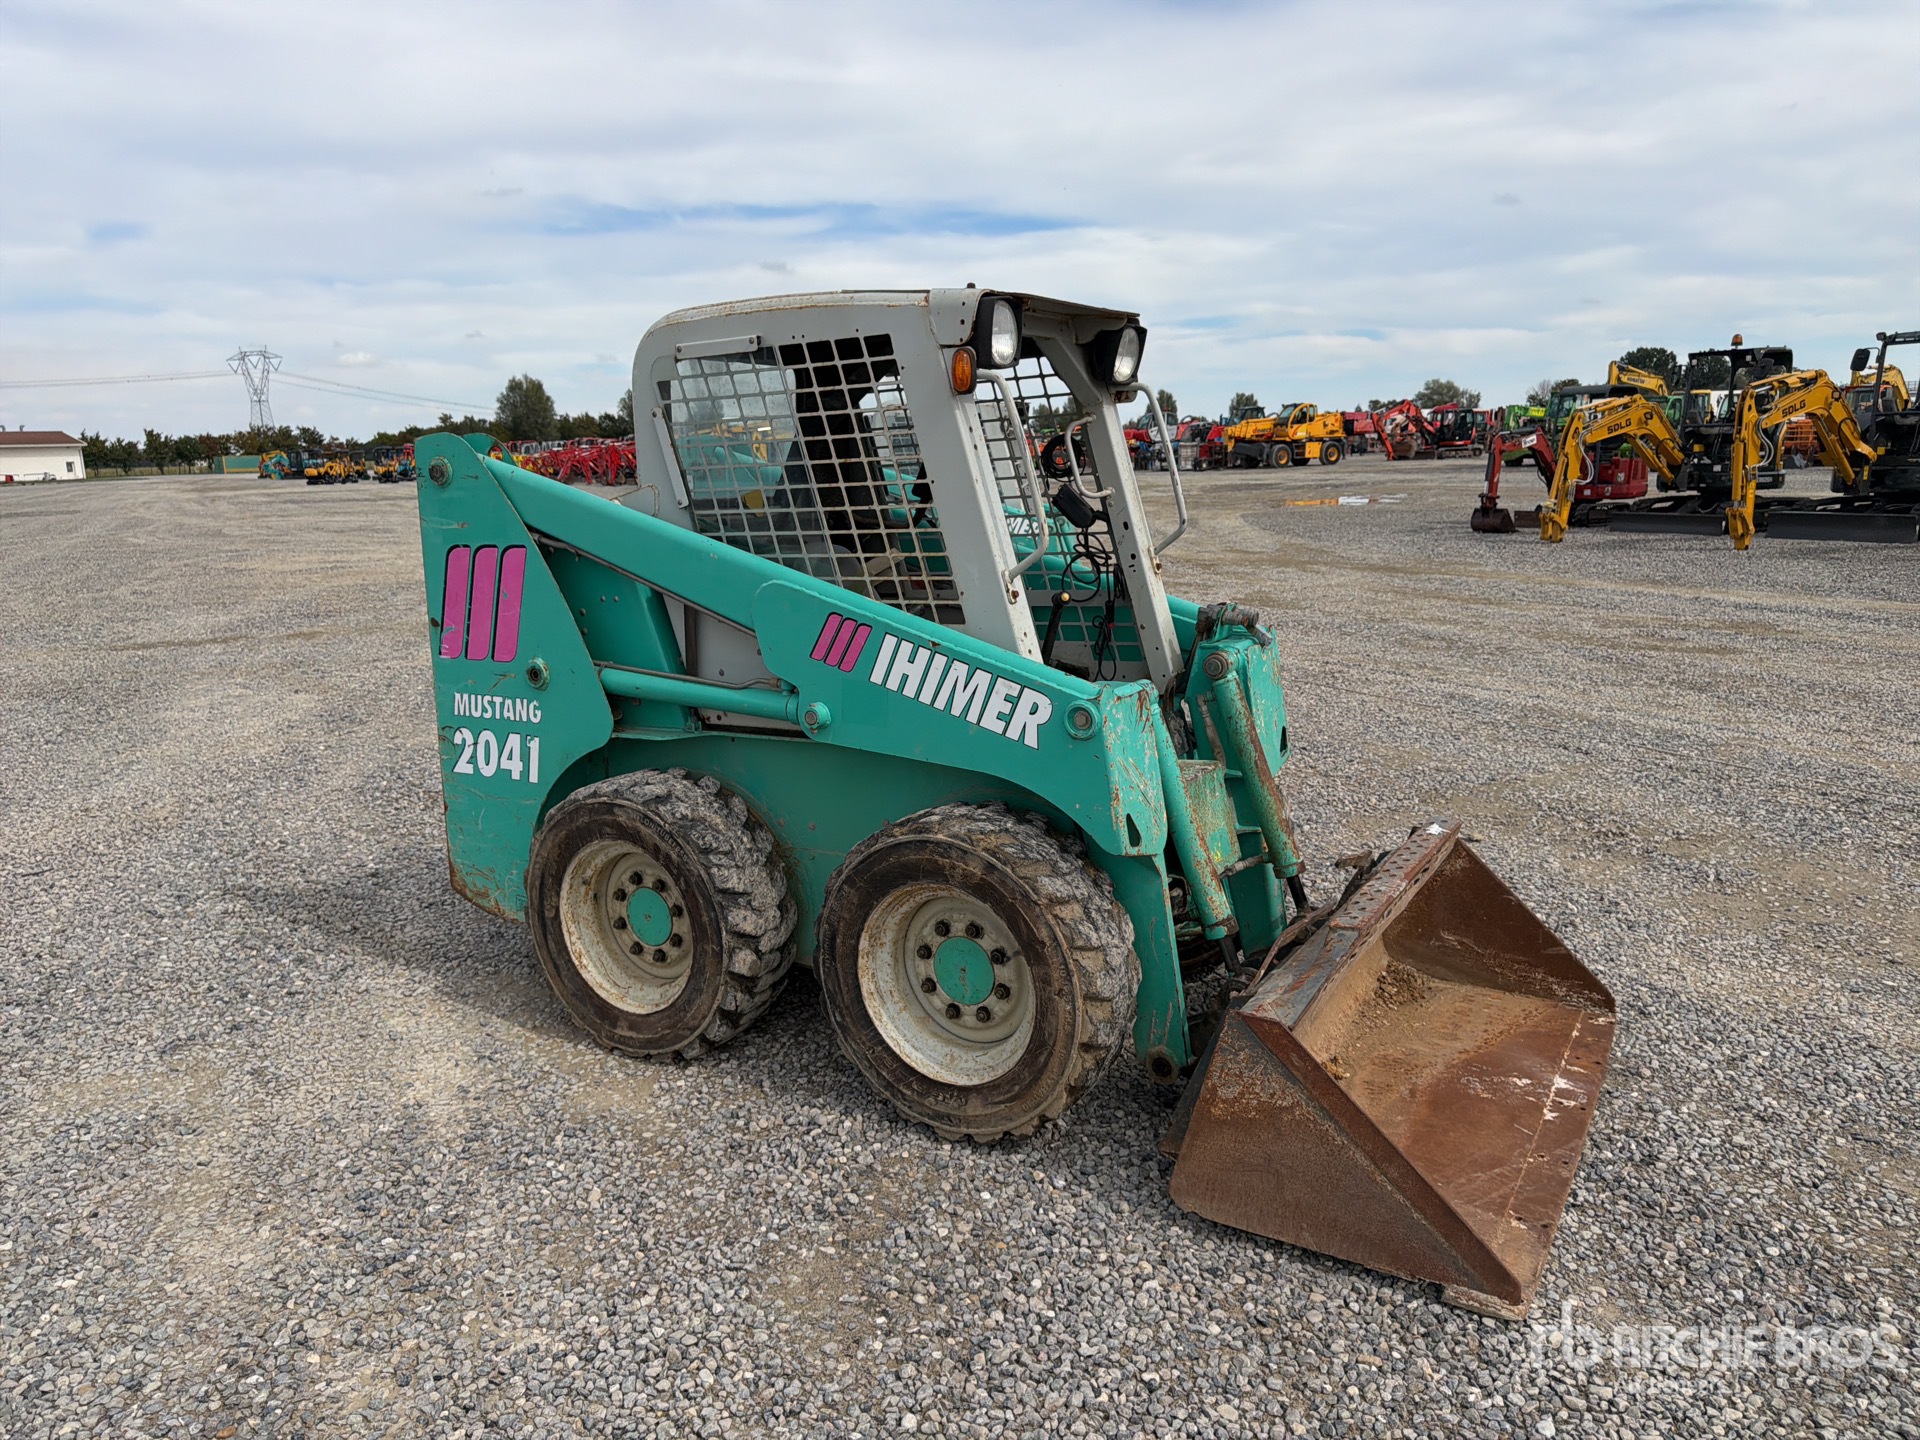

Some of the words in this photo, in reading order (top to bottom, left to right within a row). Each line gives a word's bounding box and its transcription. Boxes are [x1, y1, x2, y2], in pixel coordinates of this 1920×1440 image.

[1781, 399, 1806, 418] SDLG
[1607, 418, 1632, 434] SDLG
[869, 632, 1053, 750] IHIMER
[453, 692, 542, 724] MUSTANG
[452, 727, 541, 784] 2041
